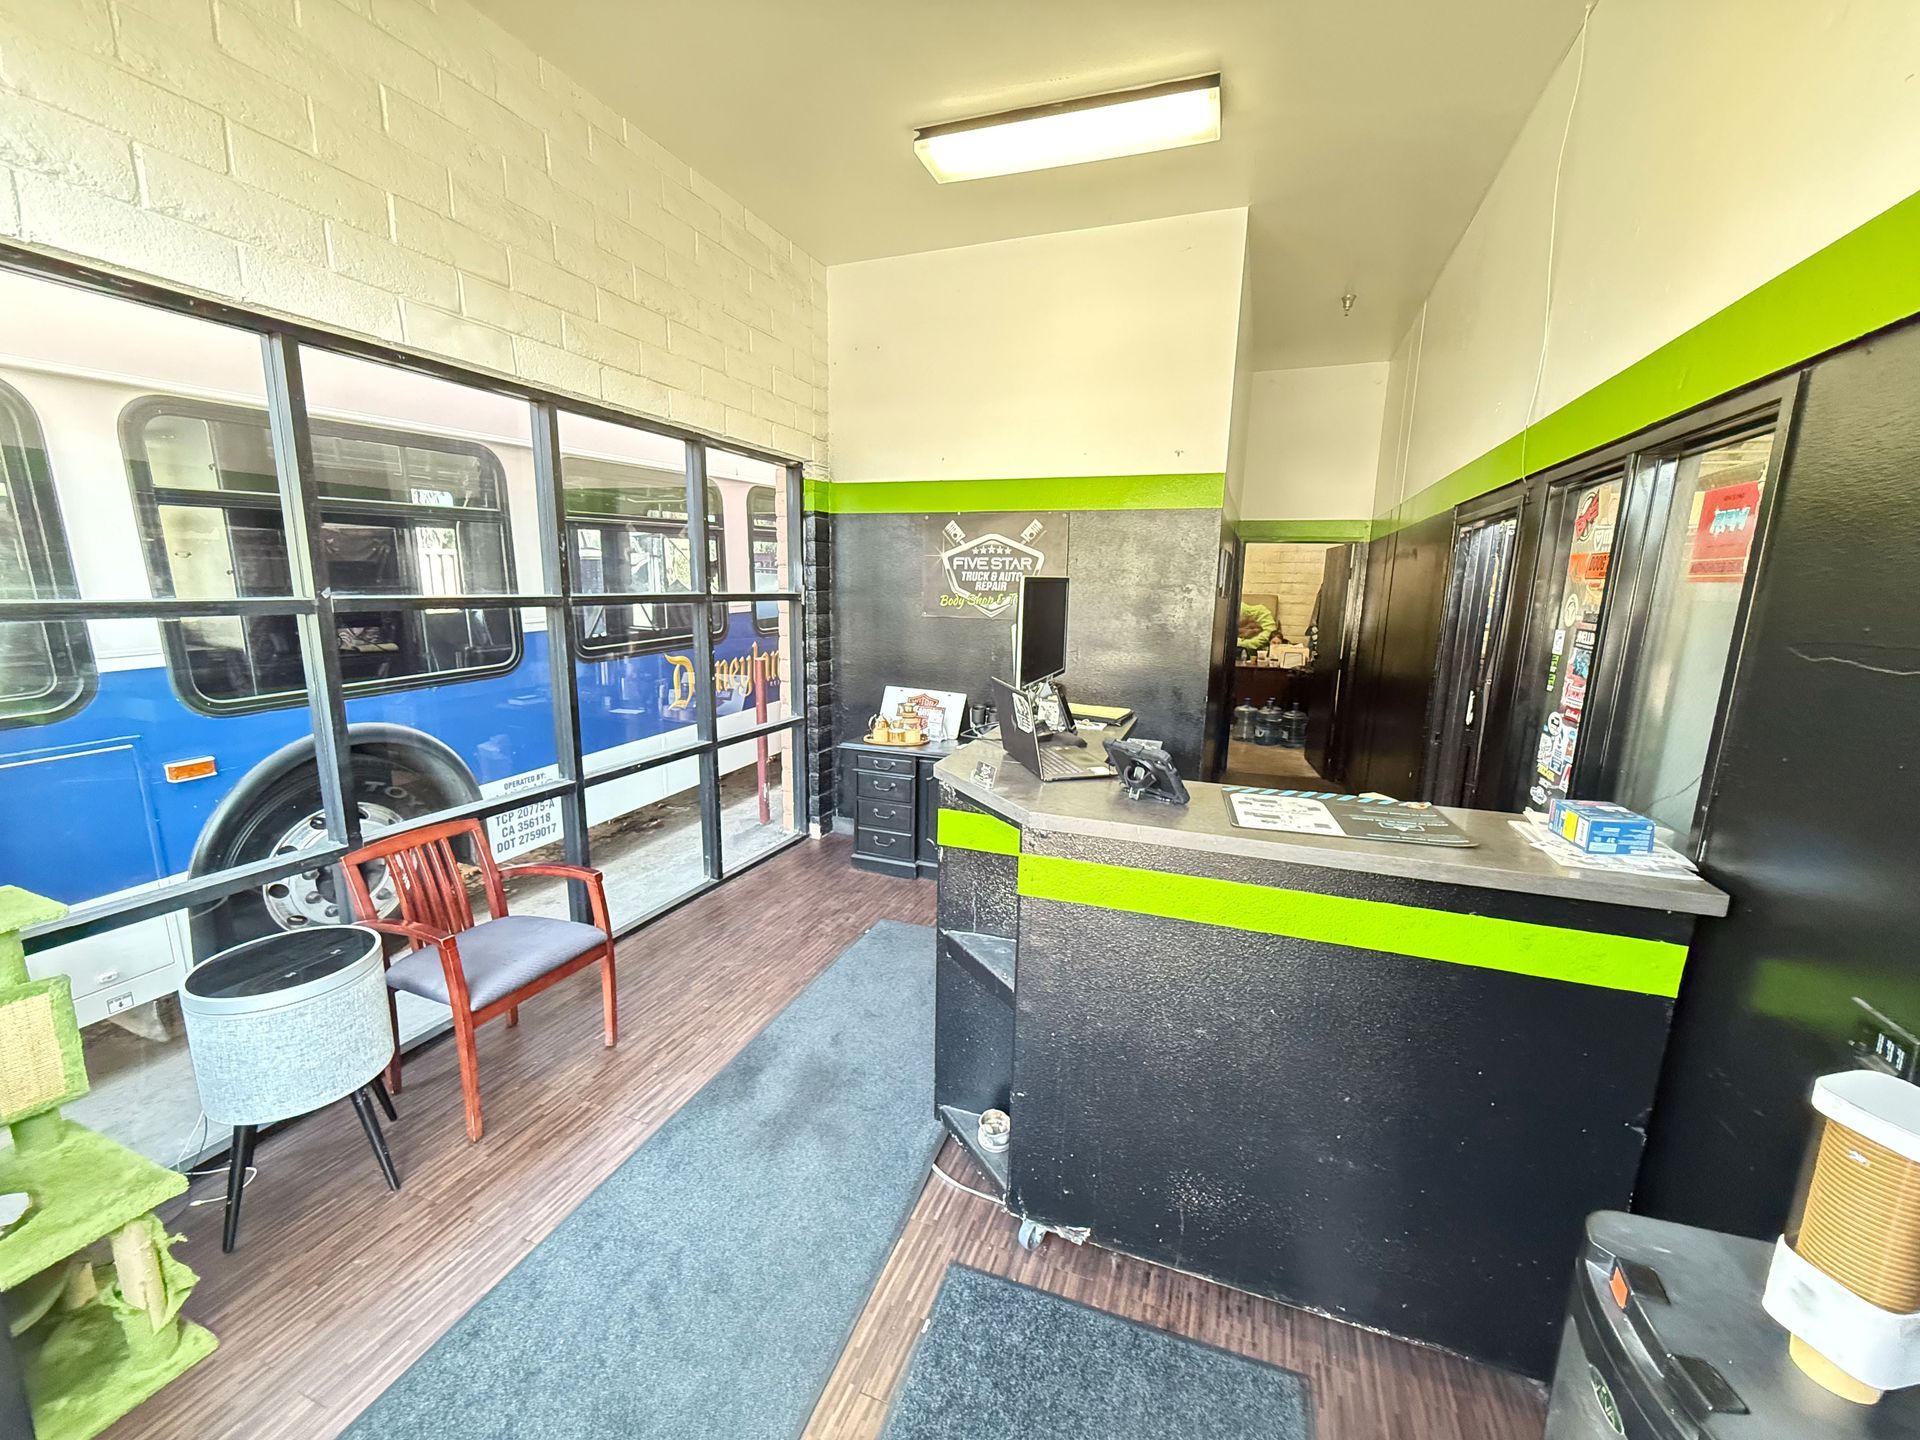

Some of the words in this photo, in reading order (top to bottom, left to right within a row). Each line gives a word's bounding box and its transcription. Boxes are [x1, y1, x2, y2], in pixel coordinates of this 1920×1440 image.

[952, 556, 990, 570] FIVE
[990, 556, 1033, 570] STAR
[961, 571, 990, 582] TRUCK
[975, 581, 1008, 591] REPAIR
[939, 594, 965, 610] Body
[503, 775, 535, 791] OPERATED
[364, 780, 426, 808] TOY
[496, 811, 516, 827] TCP
[517, 800, 555, 820] 20775-A
[501, 824, 515, 838] CA
[517, 812, 551, 833] 356118
[496, 837, 516, 854] DOT
[518, 822, 557, 846] 2759017
